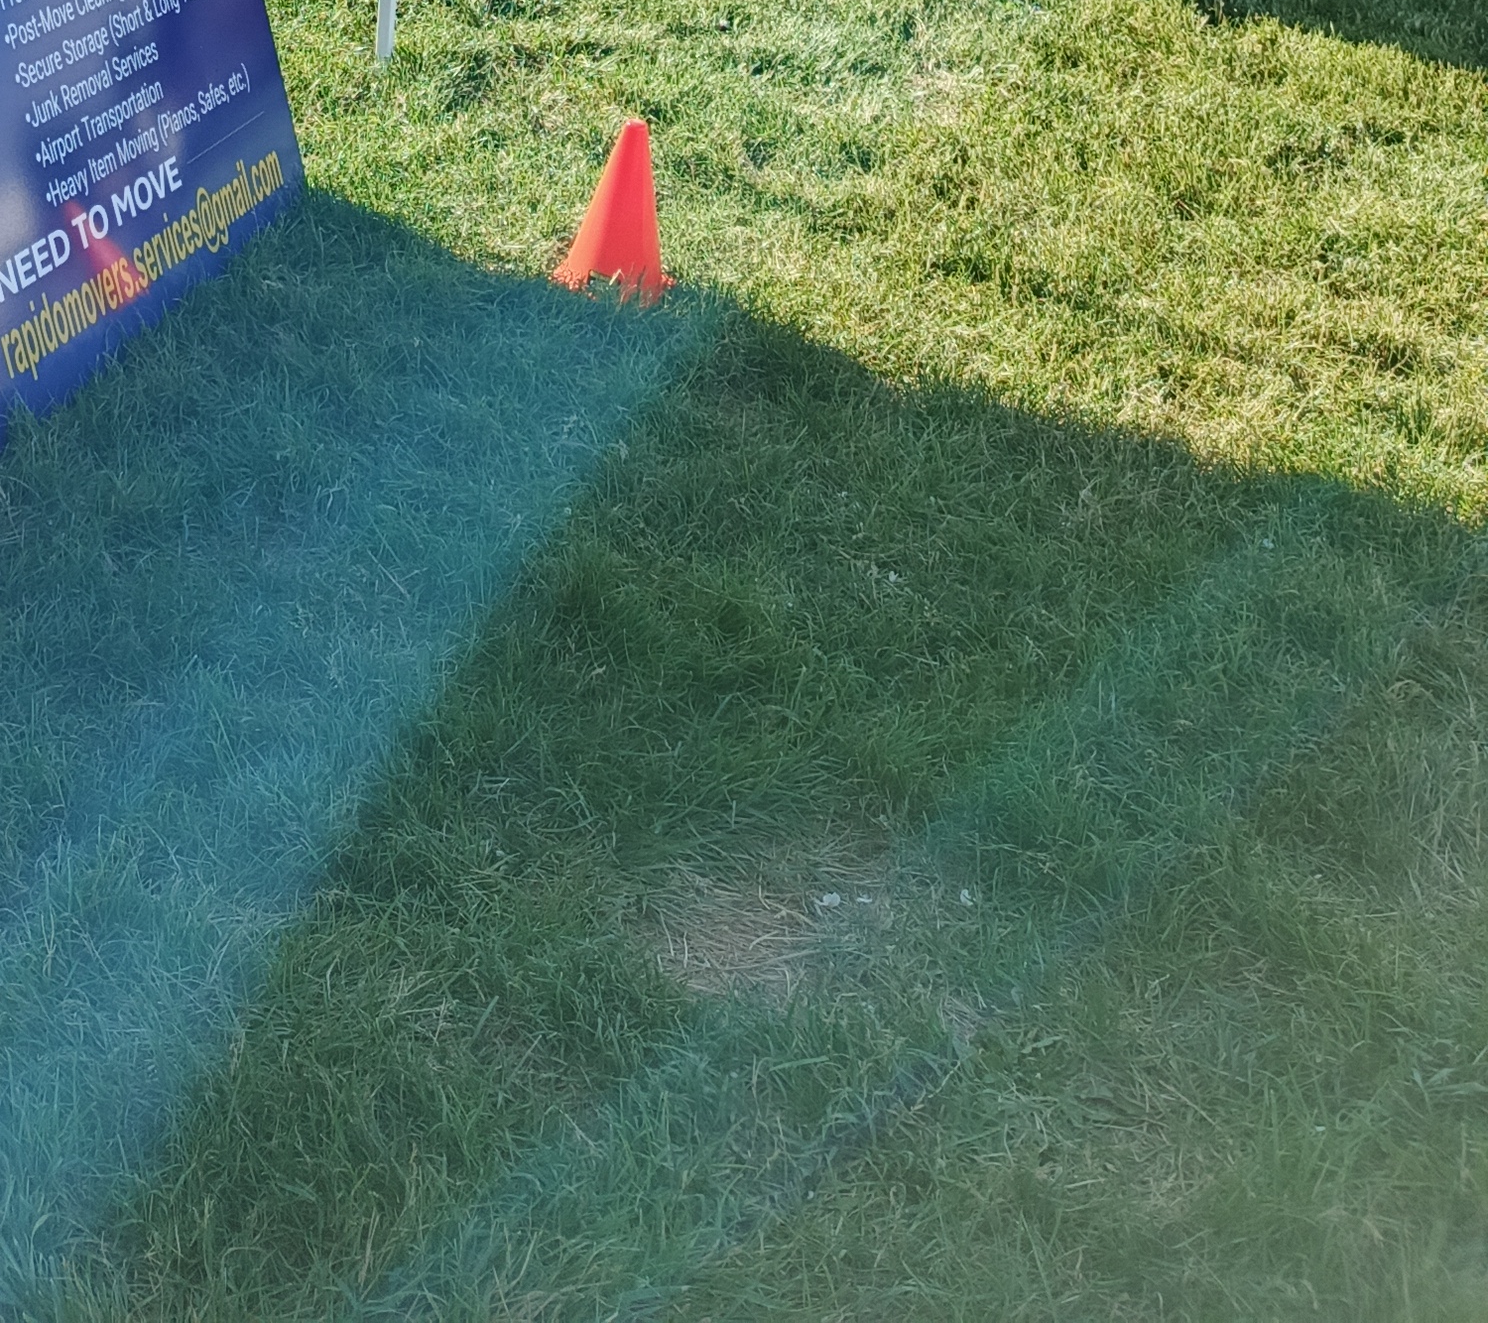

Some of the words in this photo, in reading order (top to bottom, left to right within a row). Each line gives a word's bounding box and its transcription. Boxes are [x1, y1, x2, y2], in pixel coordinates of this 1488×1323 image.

[8, 3, 75, 49] Post-Move
[62, 26, 110, 66] Storage
[108, 5, 145, 46] (Short
[60, 60, 112, 111] Removal
[111, 41, 159, 81] Services
[80, 80, 164, 151] Transportation
[87, 147, 116, 181] Item
[115, 124, 159, 168] Moving
[157, 101, 201, 146] (Pianos,
[197, 81, 230, 115] Safes,
[227, 63, 251, 99] etc.)
[70, 203, 110, 251] TO
[109, 156, 183, 226] MOVE
[0, 150, 285, 381] rapidomovers.services@gmail.com
